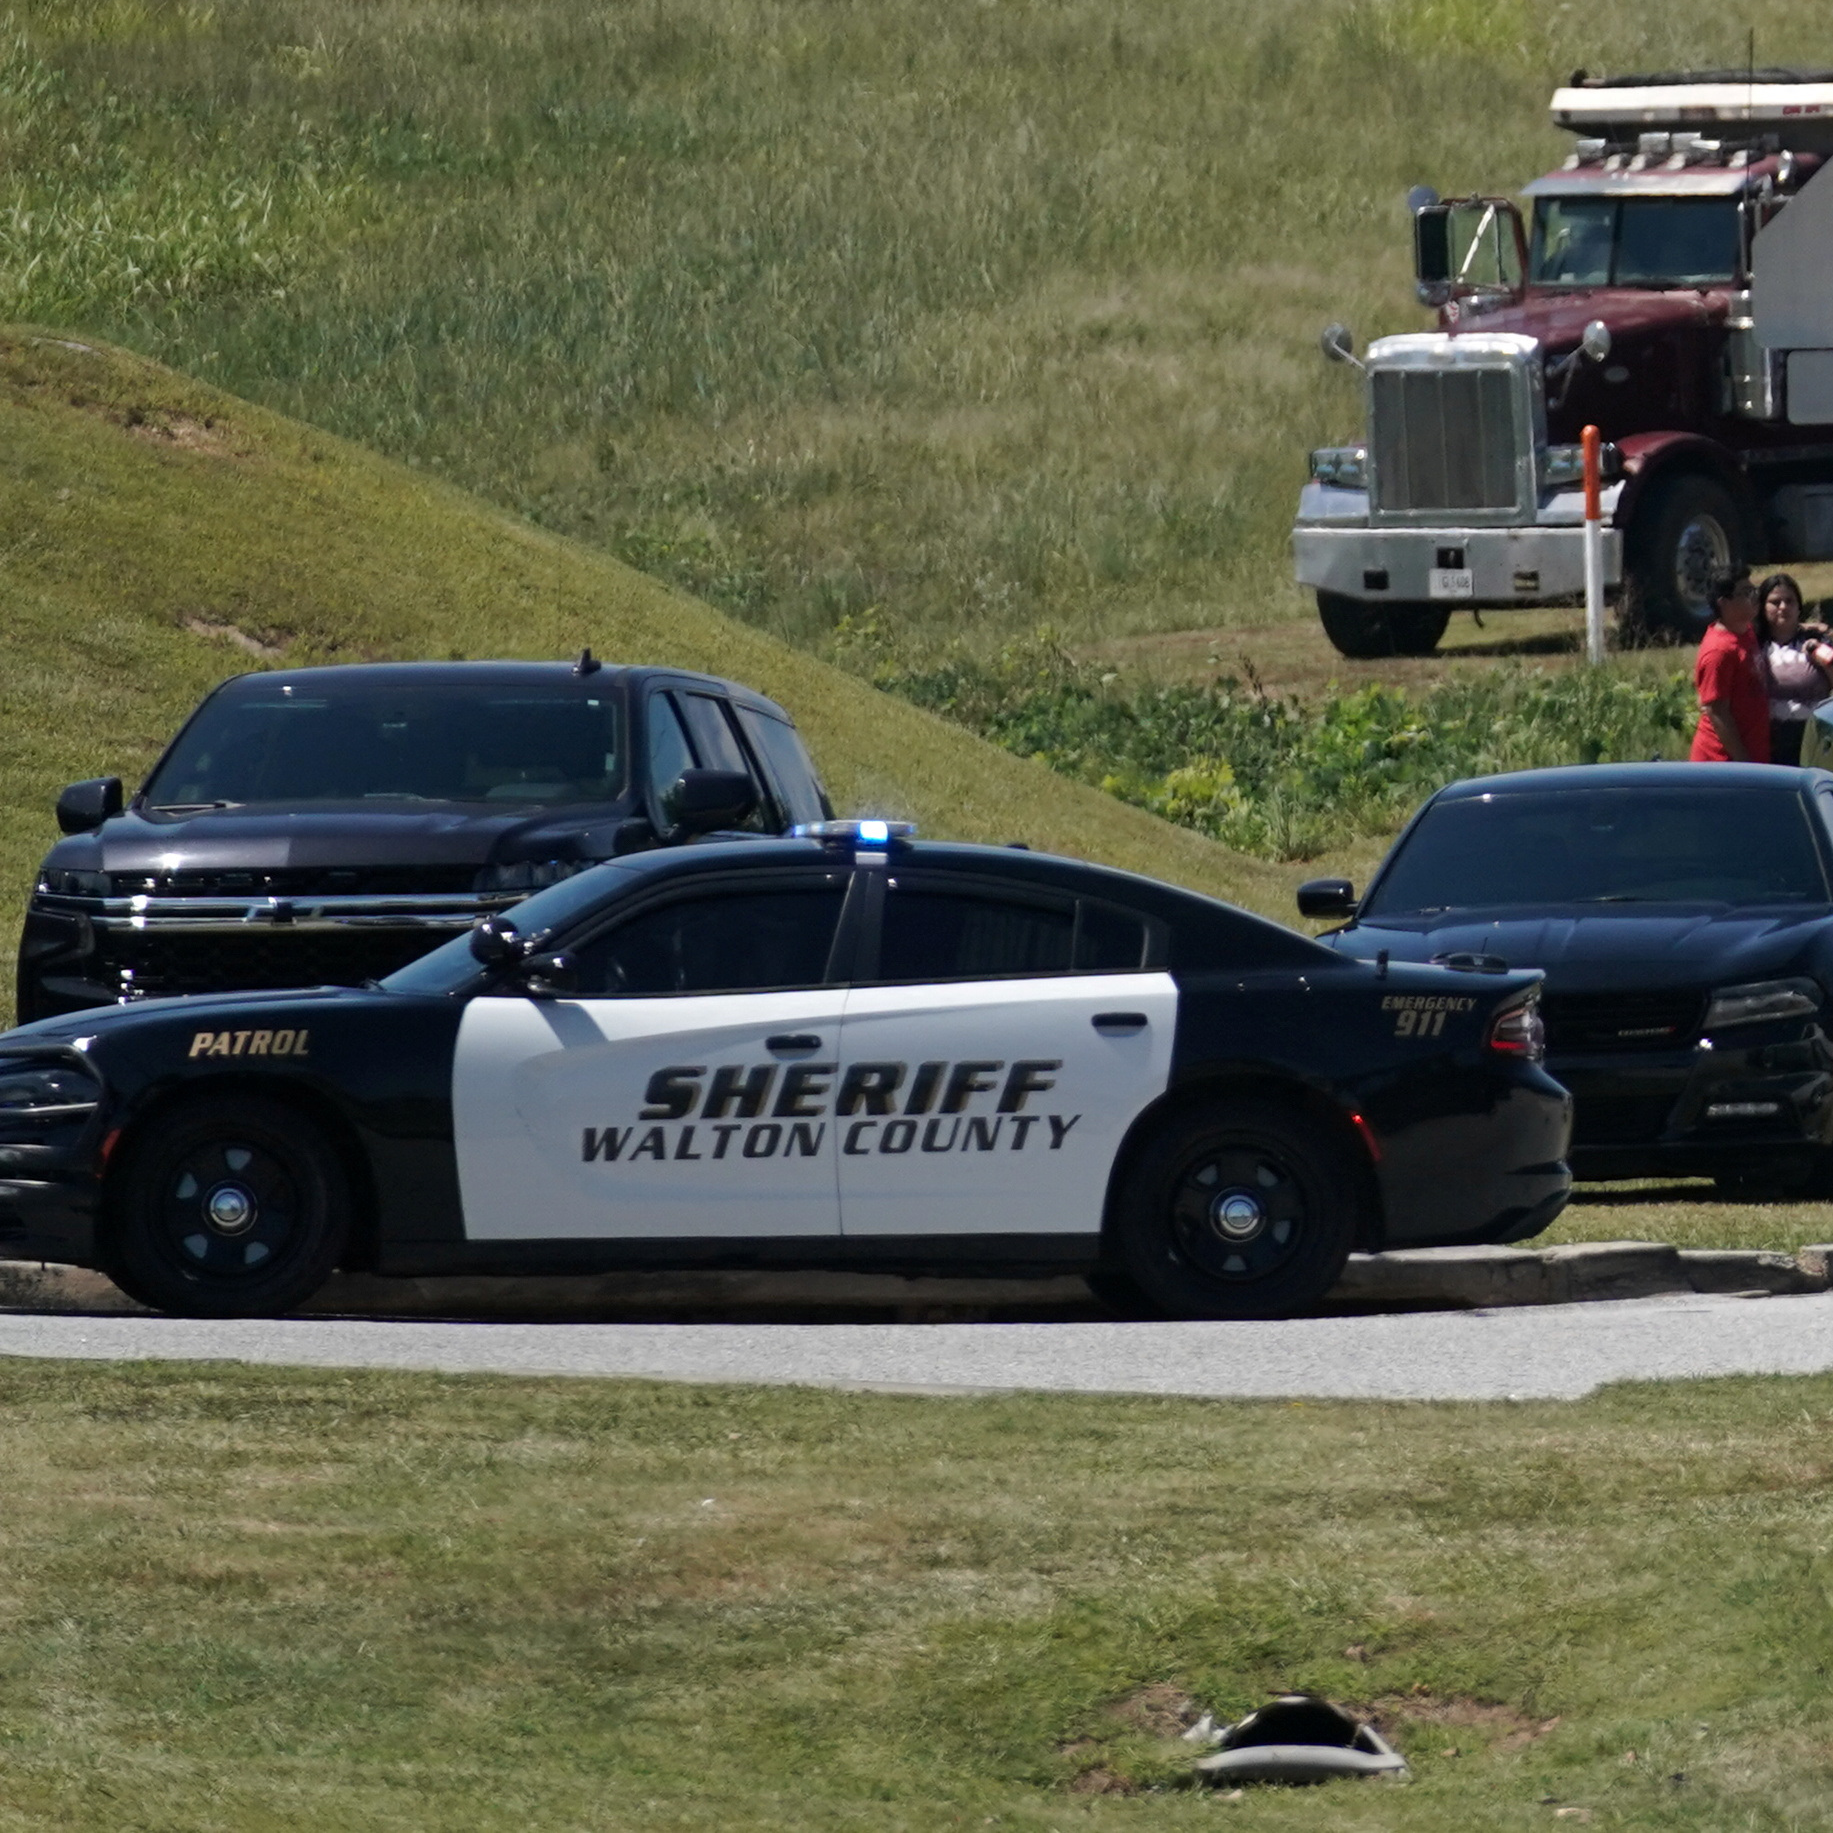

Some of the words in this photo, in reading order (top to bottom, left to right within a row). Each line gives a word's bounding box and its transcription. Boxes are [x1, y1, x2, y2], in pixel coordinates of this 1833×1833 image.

[1381, 995, 1478, 1011] EMERGENCY
[1394, 1009, 1447, 1036] 911
[188, 1029, 310, 1057] PATROL
[638, 1059, 1064, 1120] SHERIFF
[581, 1122, 826, 1162] WALTON
[843, 1114, 1083, 1155] COUNTY
